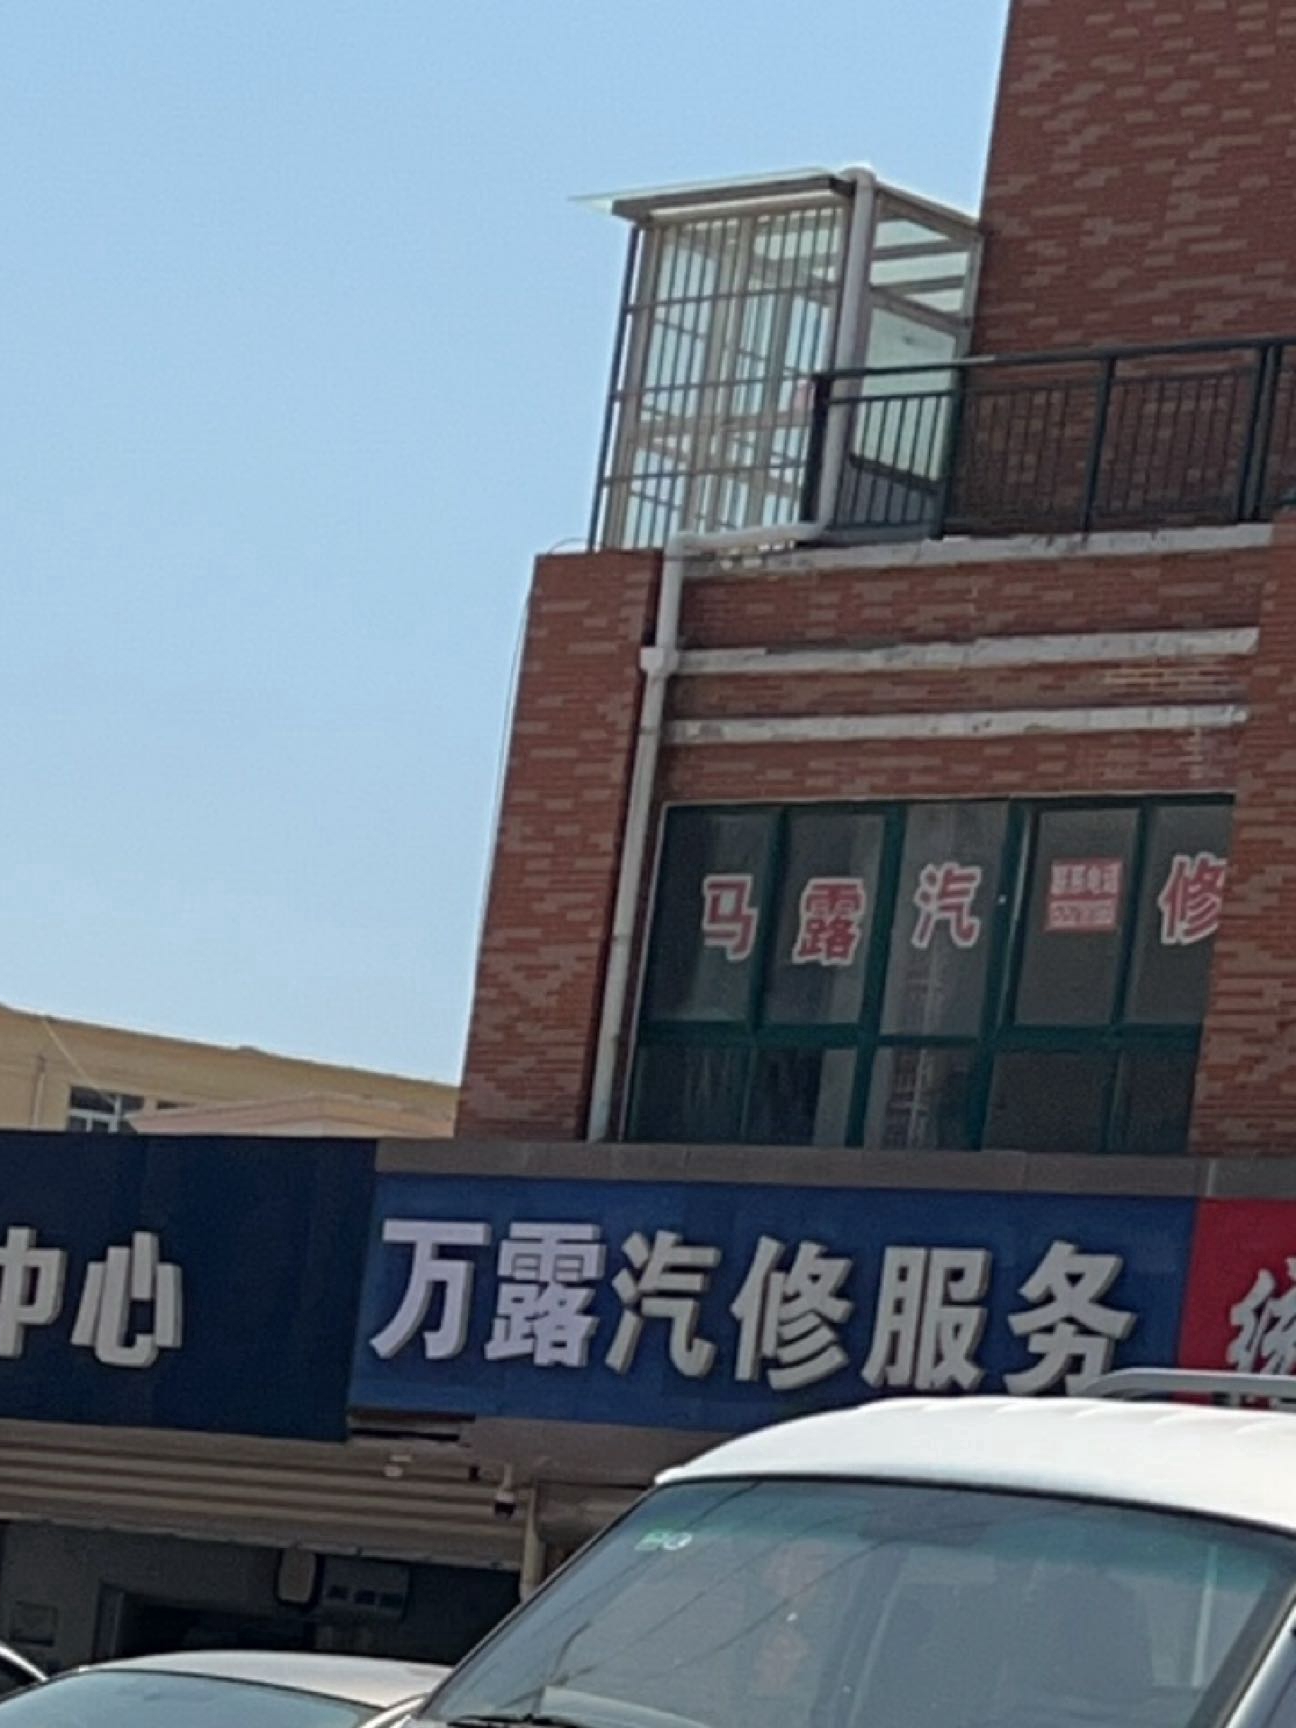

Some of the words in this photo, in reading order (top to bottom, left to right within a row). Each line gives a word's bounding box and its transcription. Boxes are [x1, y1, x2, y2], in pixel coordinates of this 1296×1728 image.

[368, 1217, 1138, 1395] 万露汽修服务
